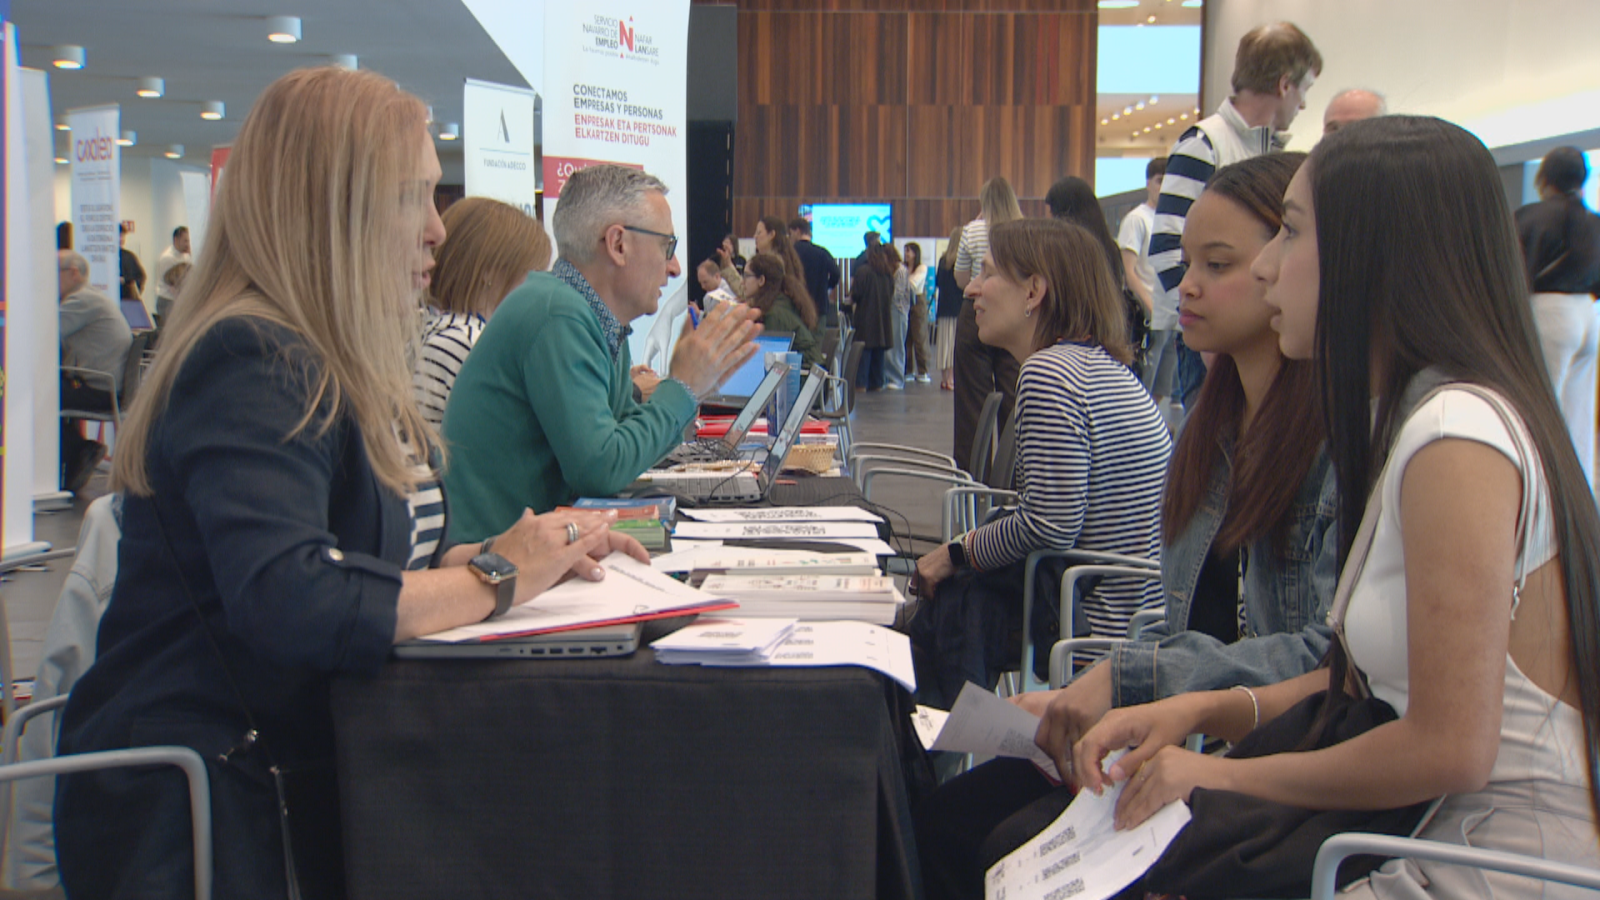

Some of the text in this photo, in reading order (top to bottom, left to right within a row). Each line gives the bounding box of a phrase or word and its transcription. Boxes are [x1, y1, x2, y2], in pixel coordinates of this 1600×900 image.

[594, 14, 618, 28] SERVICIO
[595, 36, 618, 50] EMPLEO
[635, 44, 659, 57] LANSARE
[573, 83, 628, 102] CONECTAMOS
[574, 97, 663, 120] EMPRESAS Y PERSONAS
[574, 113, 677, 137] ENPRESAK ETA PERTSONAK
[575, 126, 650, 147] ELKARTZEN DITUGU
[483, 158, 526, 171] FUNDACIÓN ADECCO
